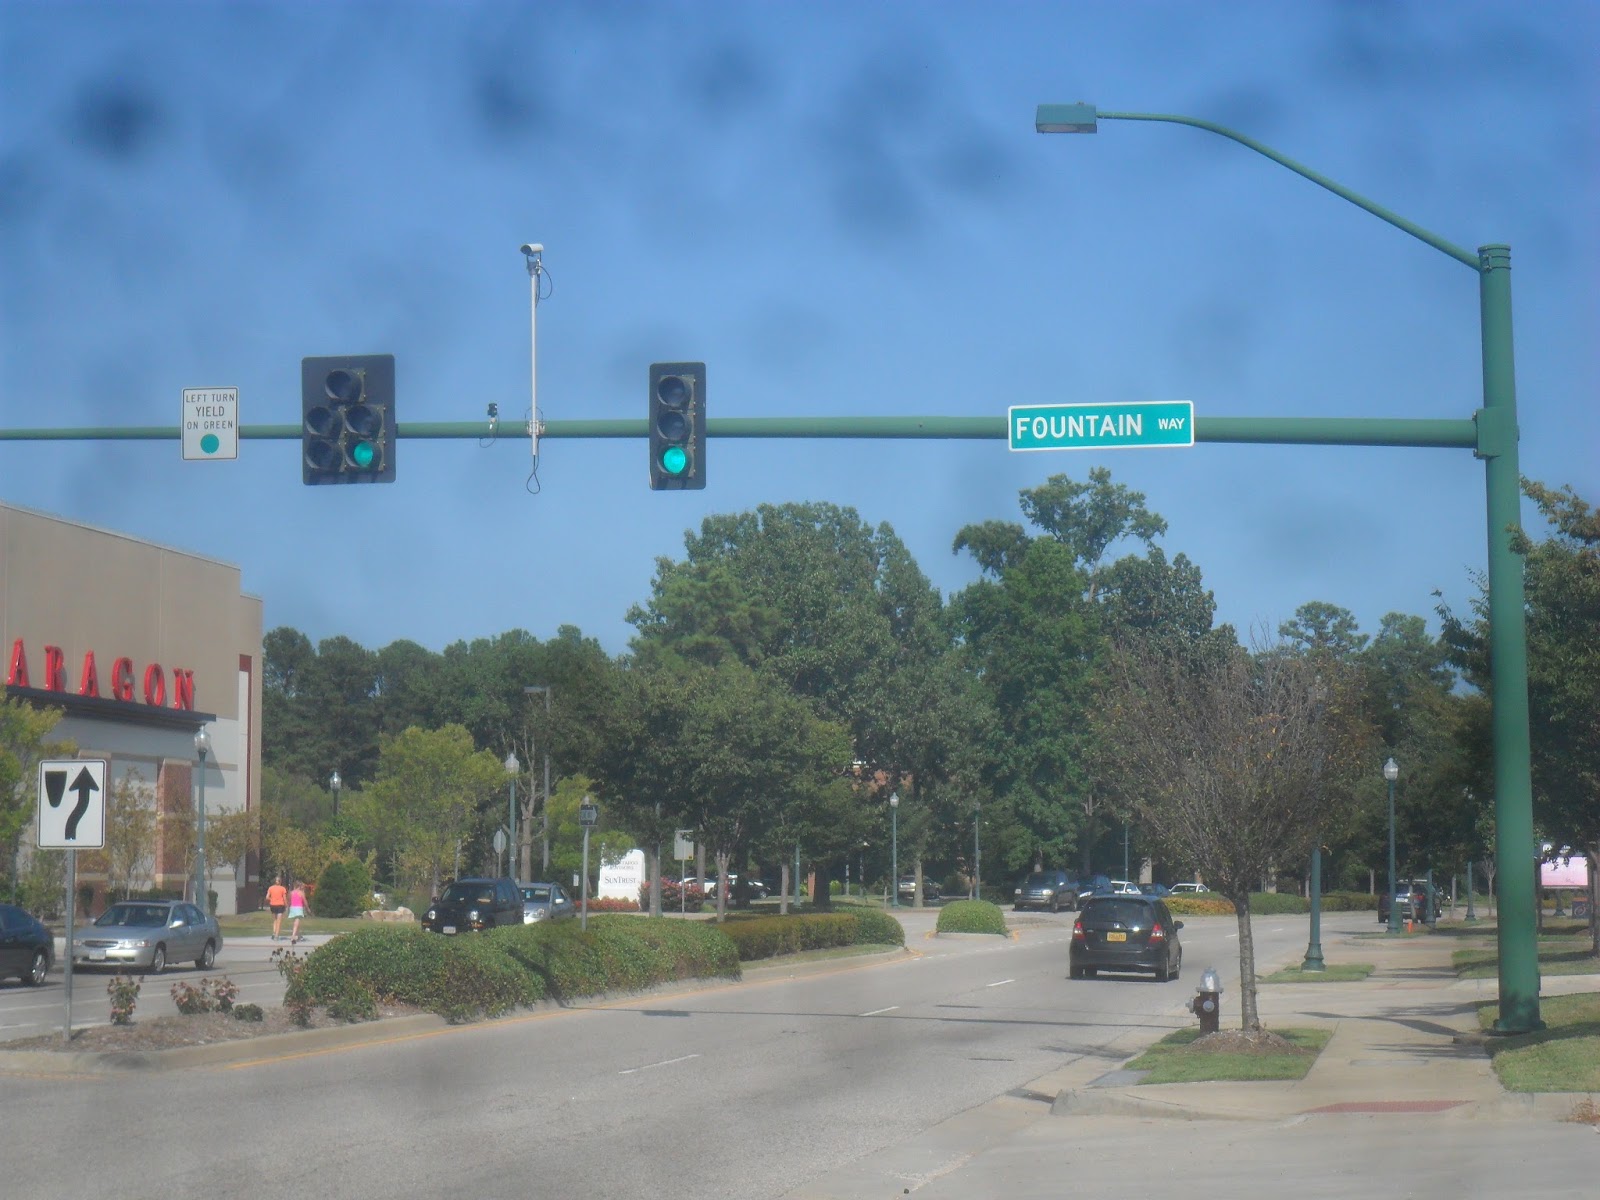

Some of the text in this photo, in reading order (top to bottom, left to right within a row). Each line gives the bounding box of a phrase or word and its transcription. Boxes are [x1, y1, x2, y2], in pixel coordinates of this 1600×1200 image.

[186, 394, 235, 403] LEFT TURN
[196, 406, 225, 417] YIELD
[187, 421, 233, 430] ON GREEN
[1017, 414, 1185, 439] FOUNTAIN WAY
[6, 637, 194, 711] ARAGON
